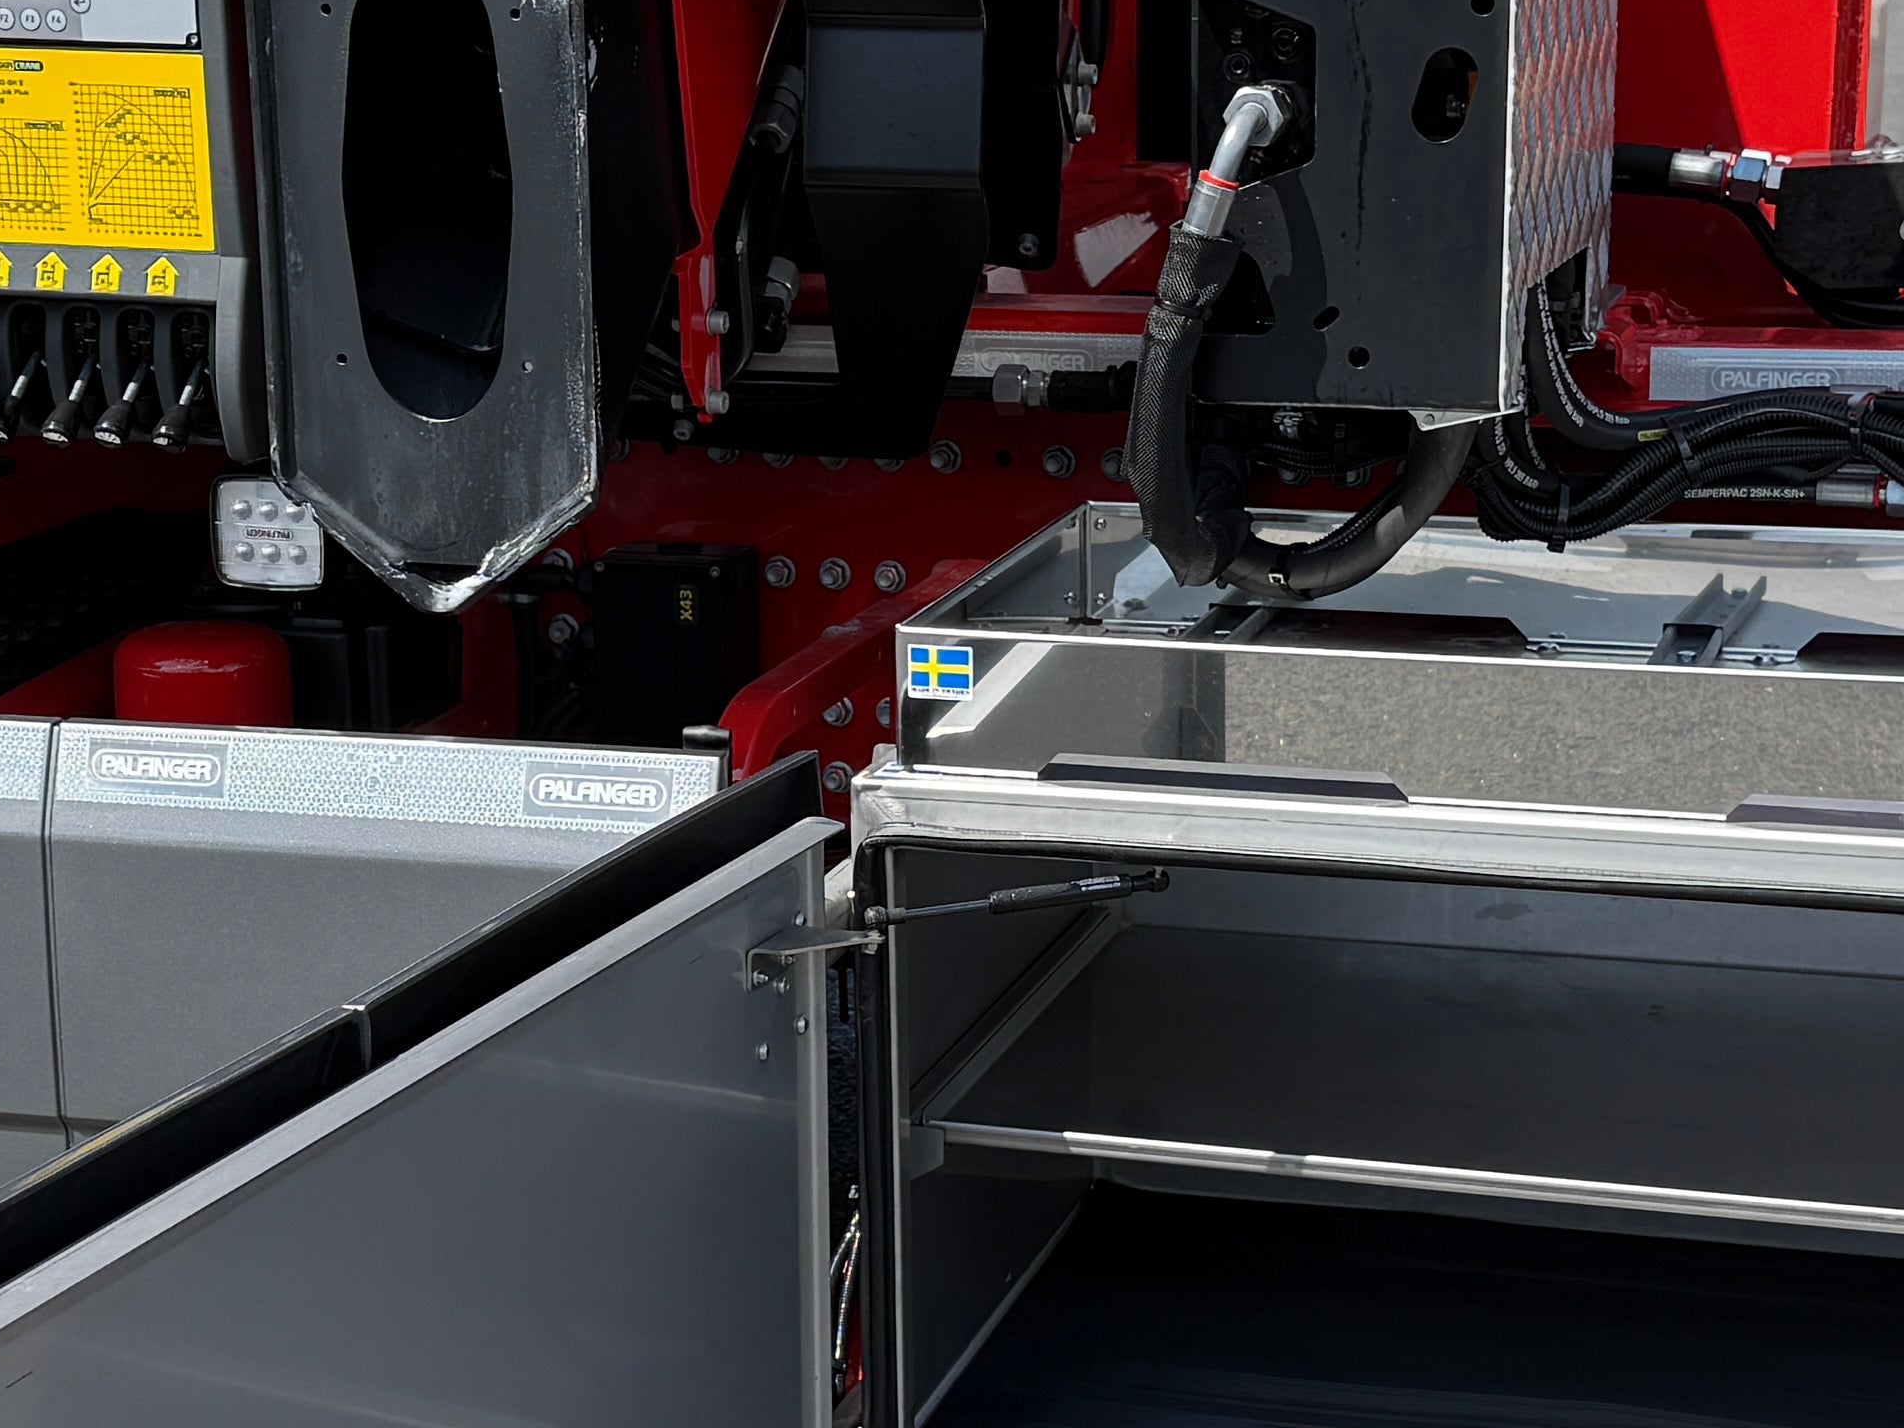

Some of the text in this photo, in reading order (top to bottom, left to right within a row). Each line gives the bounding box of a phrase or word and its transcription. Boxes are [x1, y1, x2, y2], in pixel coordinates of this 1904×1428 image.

[1720, 369, 1833, 388] PALFINGER
[1684, 487, 1746, 499] SEMPERPAC
[679, 589, 693, 621] X43
[101, 755, 212, 780] PALFINGER
[538, 778, 657, 807] PALFINGER
